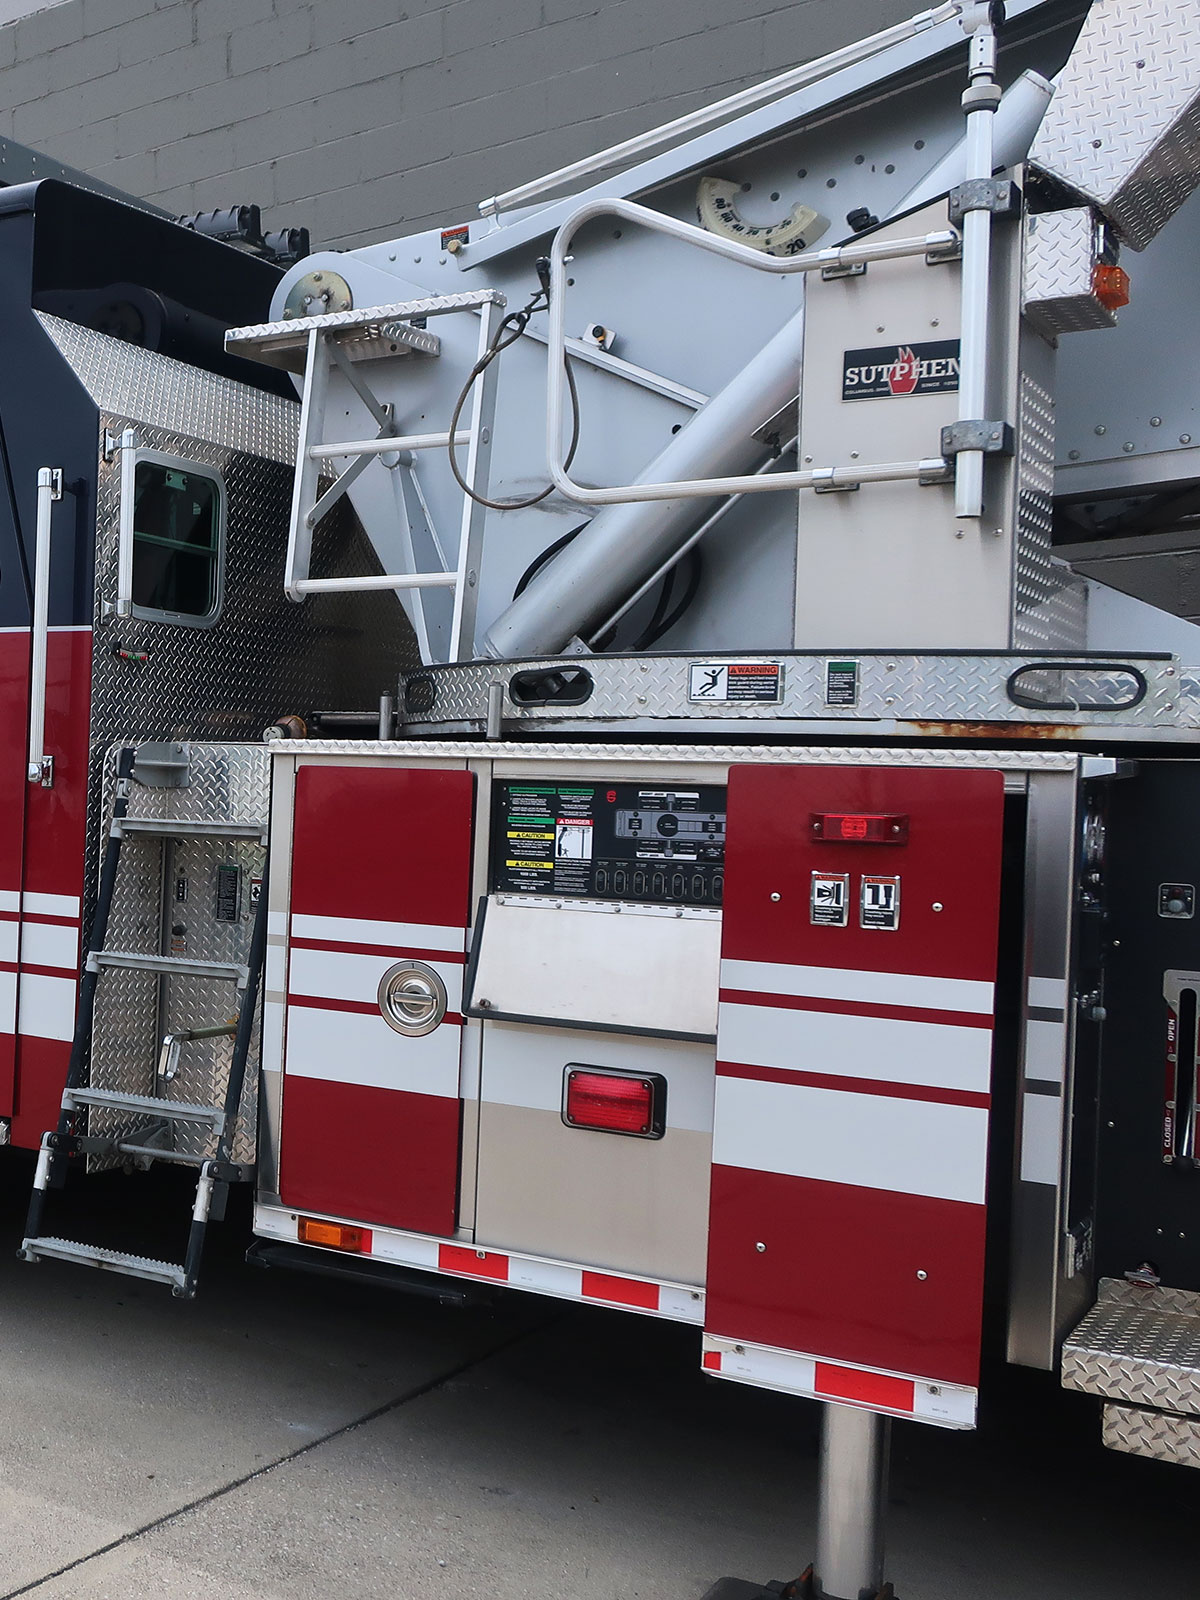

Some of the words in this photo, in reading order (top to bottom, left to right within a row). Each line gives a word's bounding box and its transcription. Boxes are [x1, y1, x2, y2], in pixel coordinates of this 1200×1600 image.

[845, 357, 960, 386] SUTPHEN
[1168, 1018, 1176, 1042] OPEN
[1163, 1117, 1172, 1148] CLOSED
